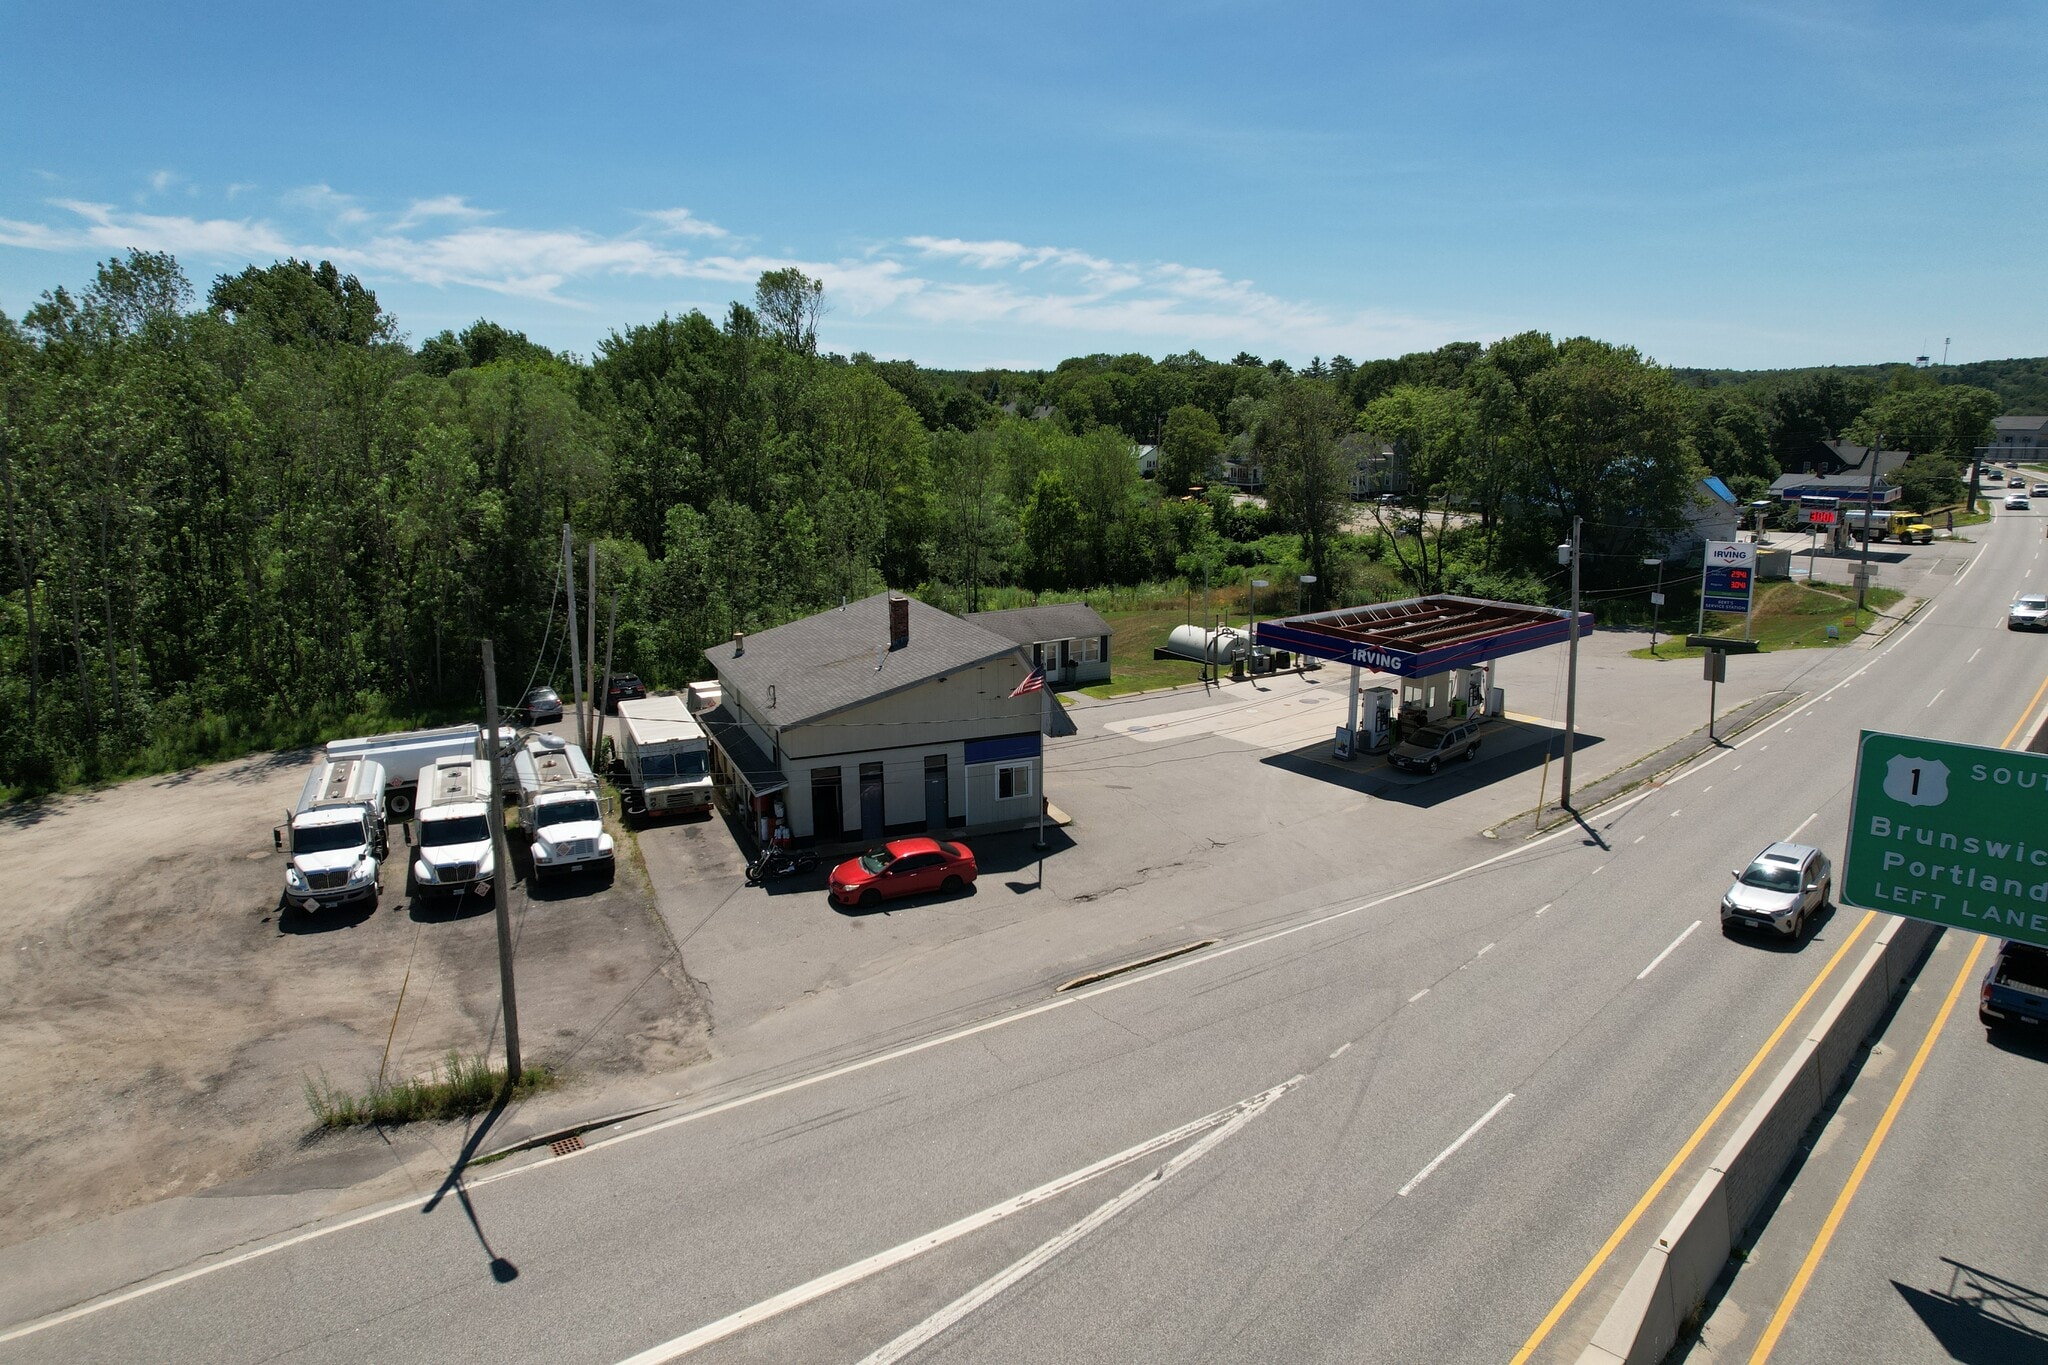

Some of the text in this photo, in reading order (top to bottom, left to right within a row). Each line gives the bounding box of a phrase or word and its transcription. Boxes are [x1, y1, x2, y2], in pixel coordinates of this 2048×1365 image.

[1713, 550, 1747, 559] IRVING
[1352, 648, 1402, 670] IRVING
[1911, 768, 1921, 796] 1
[1870, 816, 2048, 866] Brunswic
[1883, 851, 2048, 902] Portland
[1874, 882, 2048, 932] LEFT LANE
